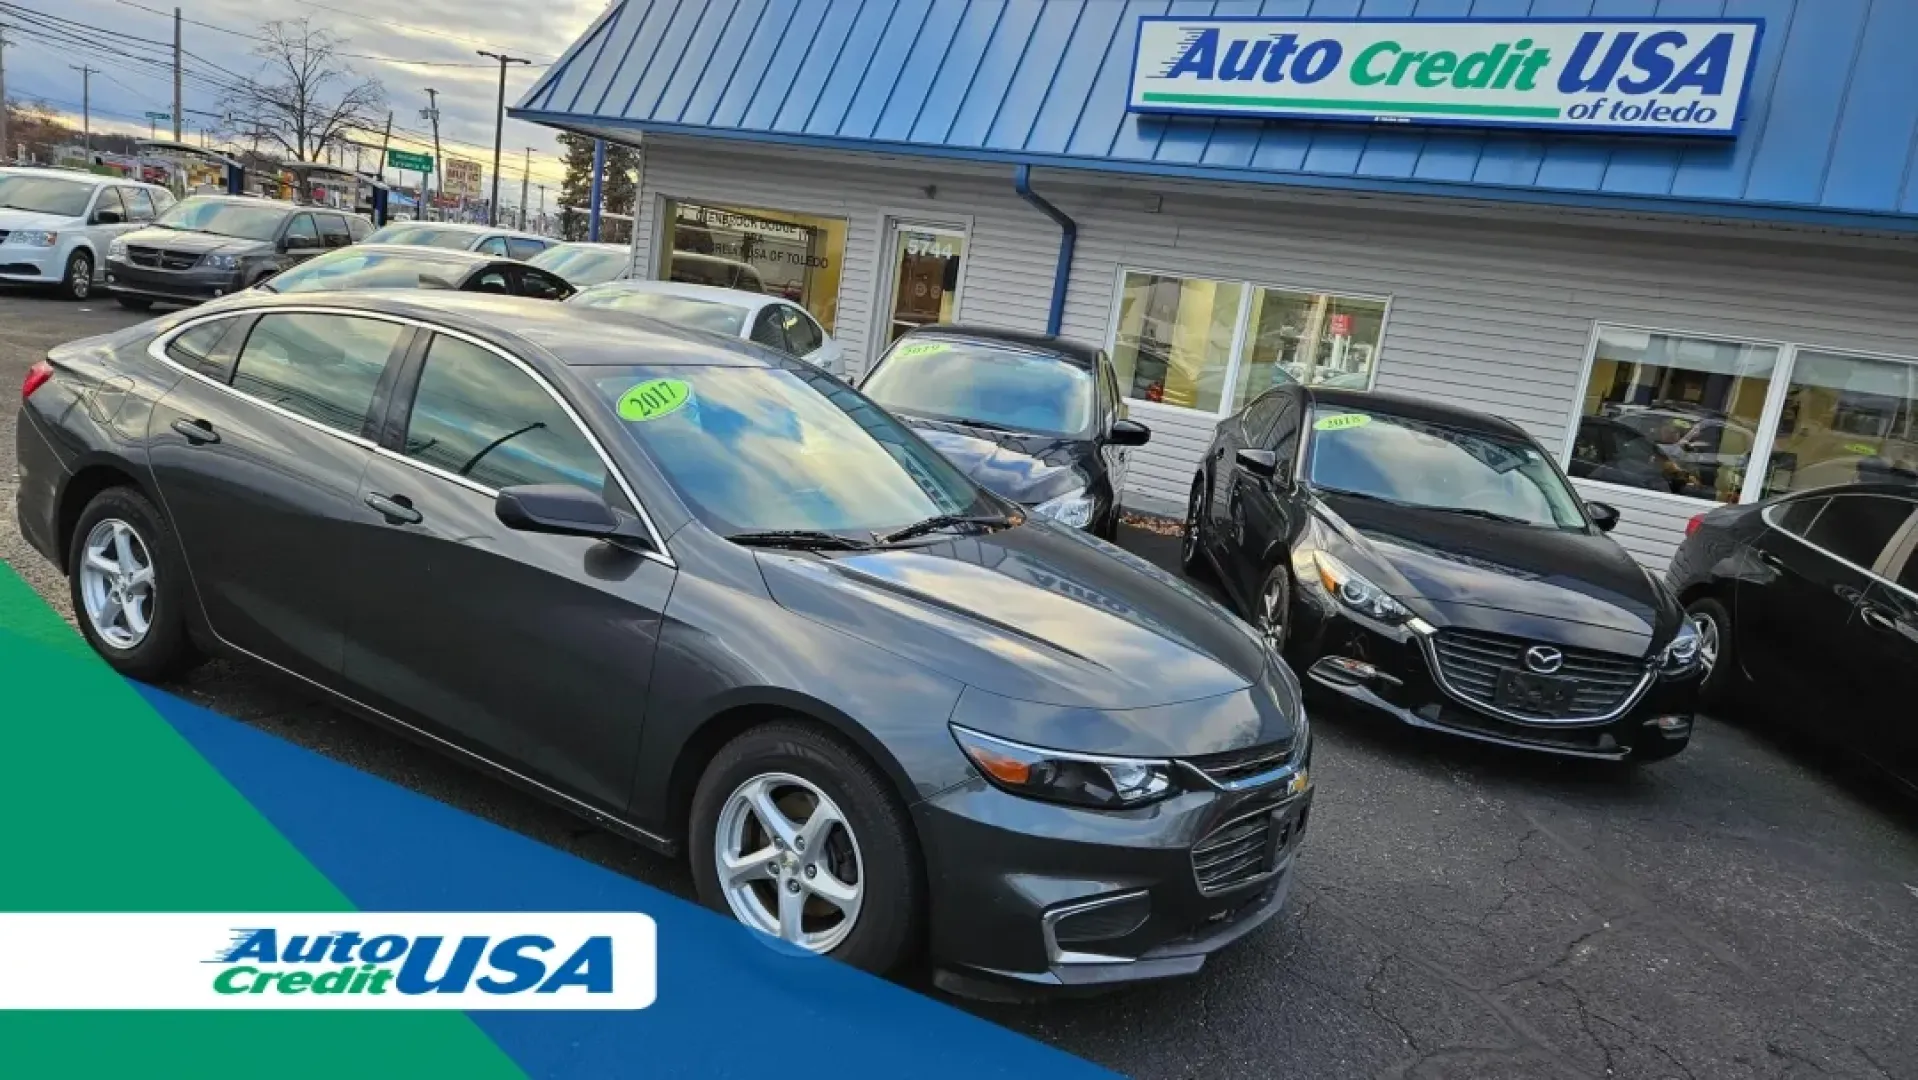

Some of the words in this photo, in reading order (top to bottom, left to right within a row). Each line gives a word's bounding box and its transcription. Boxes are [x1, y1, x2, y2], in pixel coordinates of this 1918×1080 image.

[1158, 27, 1343, 85] Auto
[1349, 38, 1551, 91] Credit
[1556, 30, 1735, 96] USA
[1567, 97, 1608, 120] of
[1608, 99, 1717, 124] toledo
[770, 249, 784, 263] OF
[787, 252, 829, 269] TOLEDO
[907, 240, 953, 260] 5744
[629, 382, 677, 416] 2017
